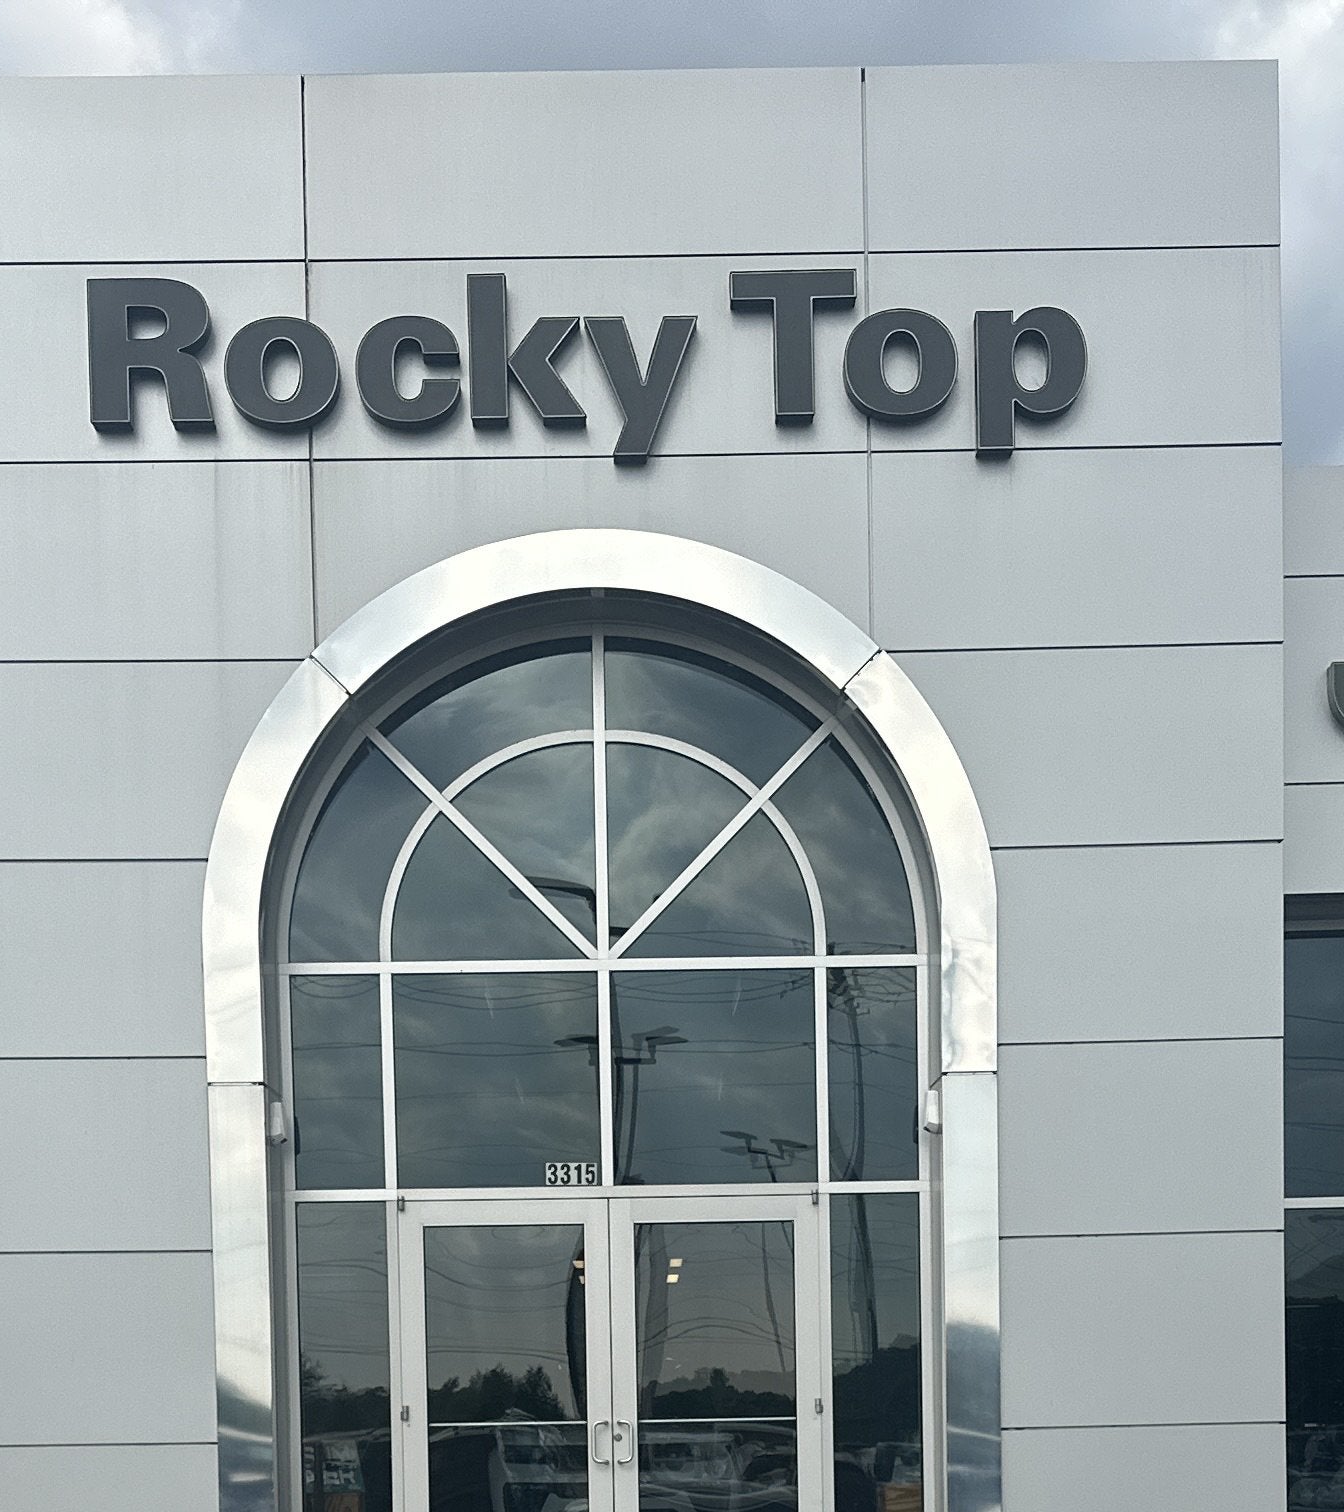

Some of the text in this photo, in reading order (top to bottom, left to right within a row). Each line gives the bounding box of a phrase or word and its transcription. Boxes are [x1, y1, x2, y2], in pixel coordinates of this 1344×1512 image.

[86, 268, 1088, 465] Rocky Top
[547, 1163, 596, 1185] 3315
